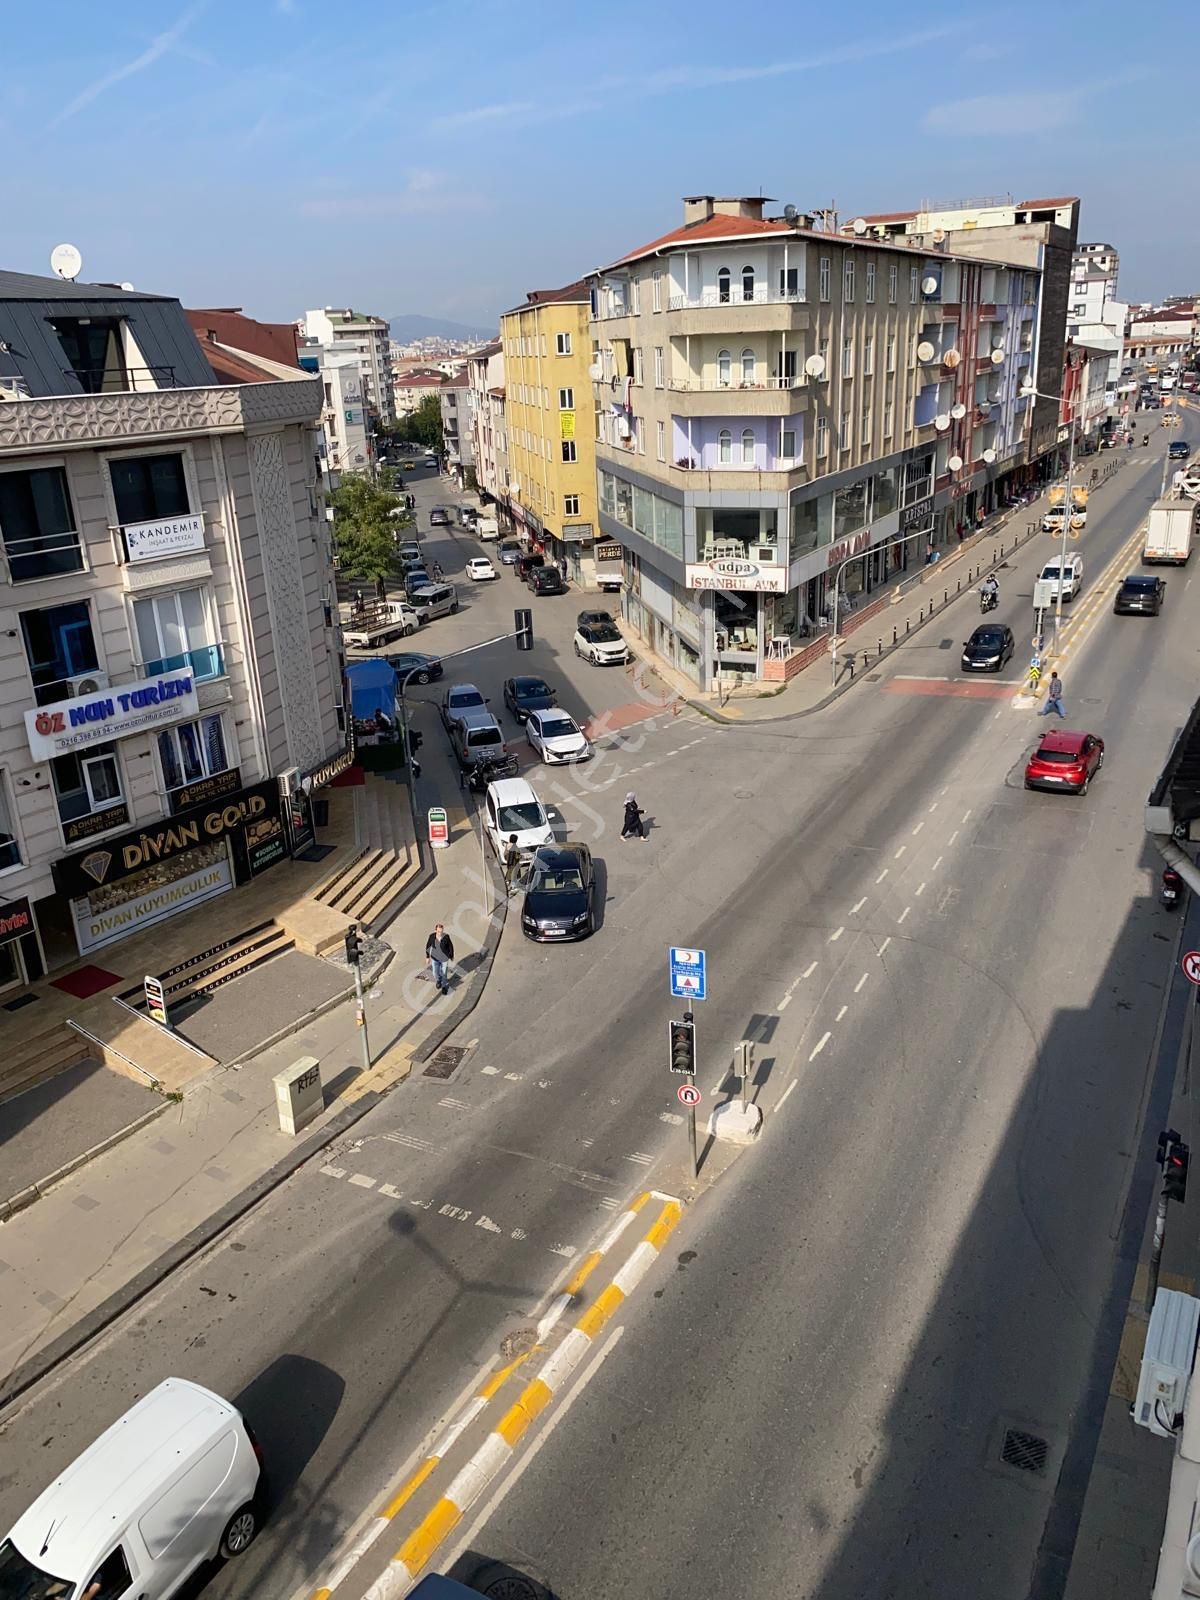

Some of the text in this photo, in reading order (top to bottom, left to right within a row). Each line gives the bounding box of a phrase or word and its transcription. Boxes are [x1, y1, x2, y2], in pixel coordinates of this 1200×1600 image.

[139, 520, 199, 540] KANDEMİR
[718, 561, 751, 575] udpa
[691, 574, 779, 591] İSTANBUL AVM
[35, 677, 192, 736] ÖZ NUH TURİZM
[61, 736, 78, 746] 0216
[190, 772, 237, 794] OKRA YAPI
[78, 807, 125, 829] OKRA YAPI
[122, 795, 266, 869] DİVAN GOLD
[90, 909, 133, 937] DİVAN
[135, 870, 222, 918] KUYUMCULUK
[164, 946, 255, 996] DİVAN KUYUMCULUK
